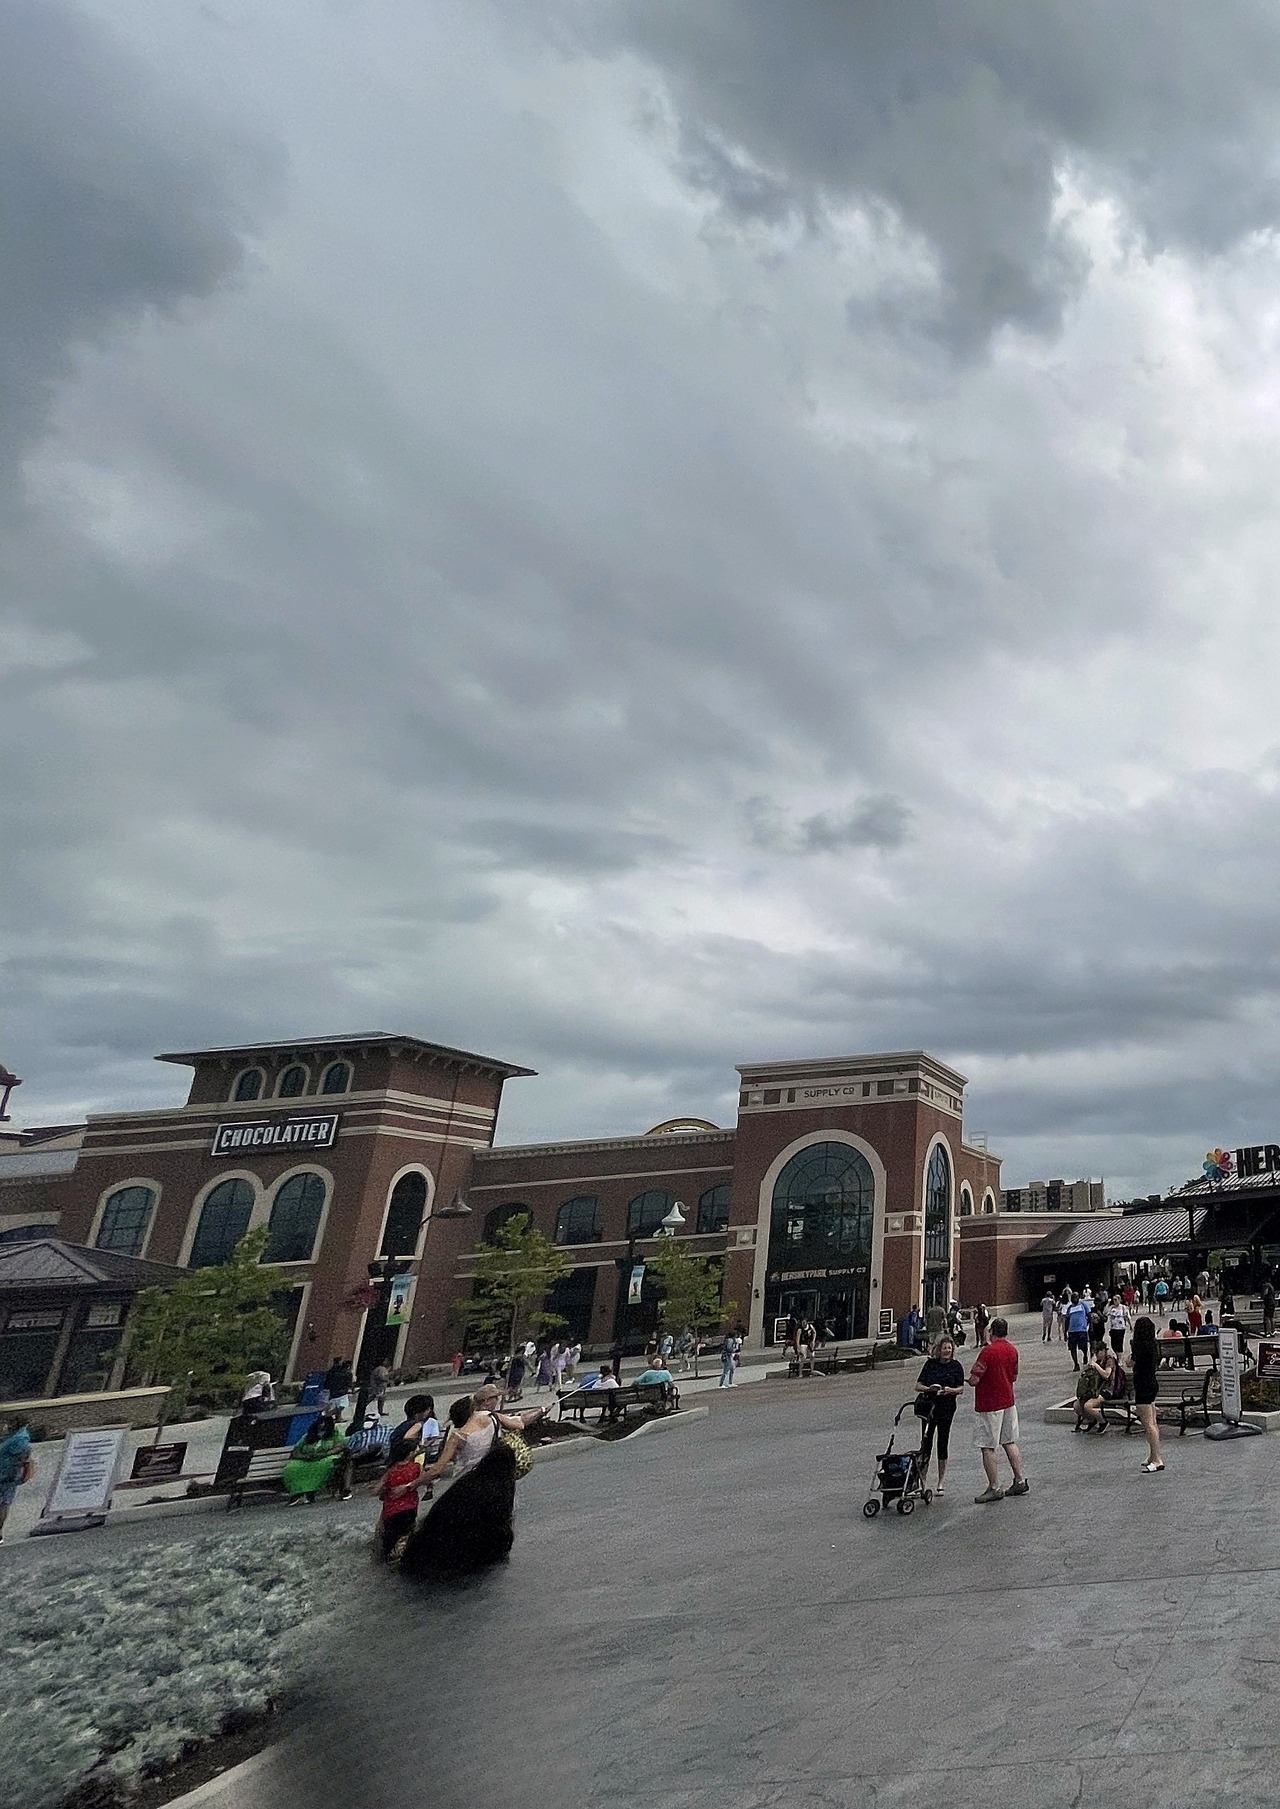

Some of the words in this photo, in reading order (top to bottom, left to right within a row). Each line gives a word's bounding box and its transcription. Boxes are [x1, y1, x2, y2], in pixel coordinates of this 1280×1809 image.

[804, 1087, 840, 1098] SUPPLY
[220, 1122, 330, 1148] CHOCOLATIER
[828, 1267, 854, 1276] SUPPLY
